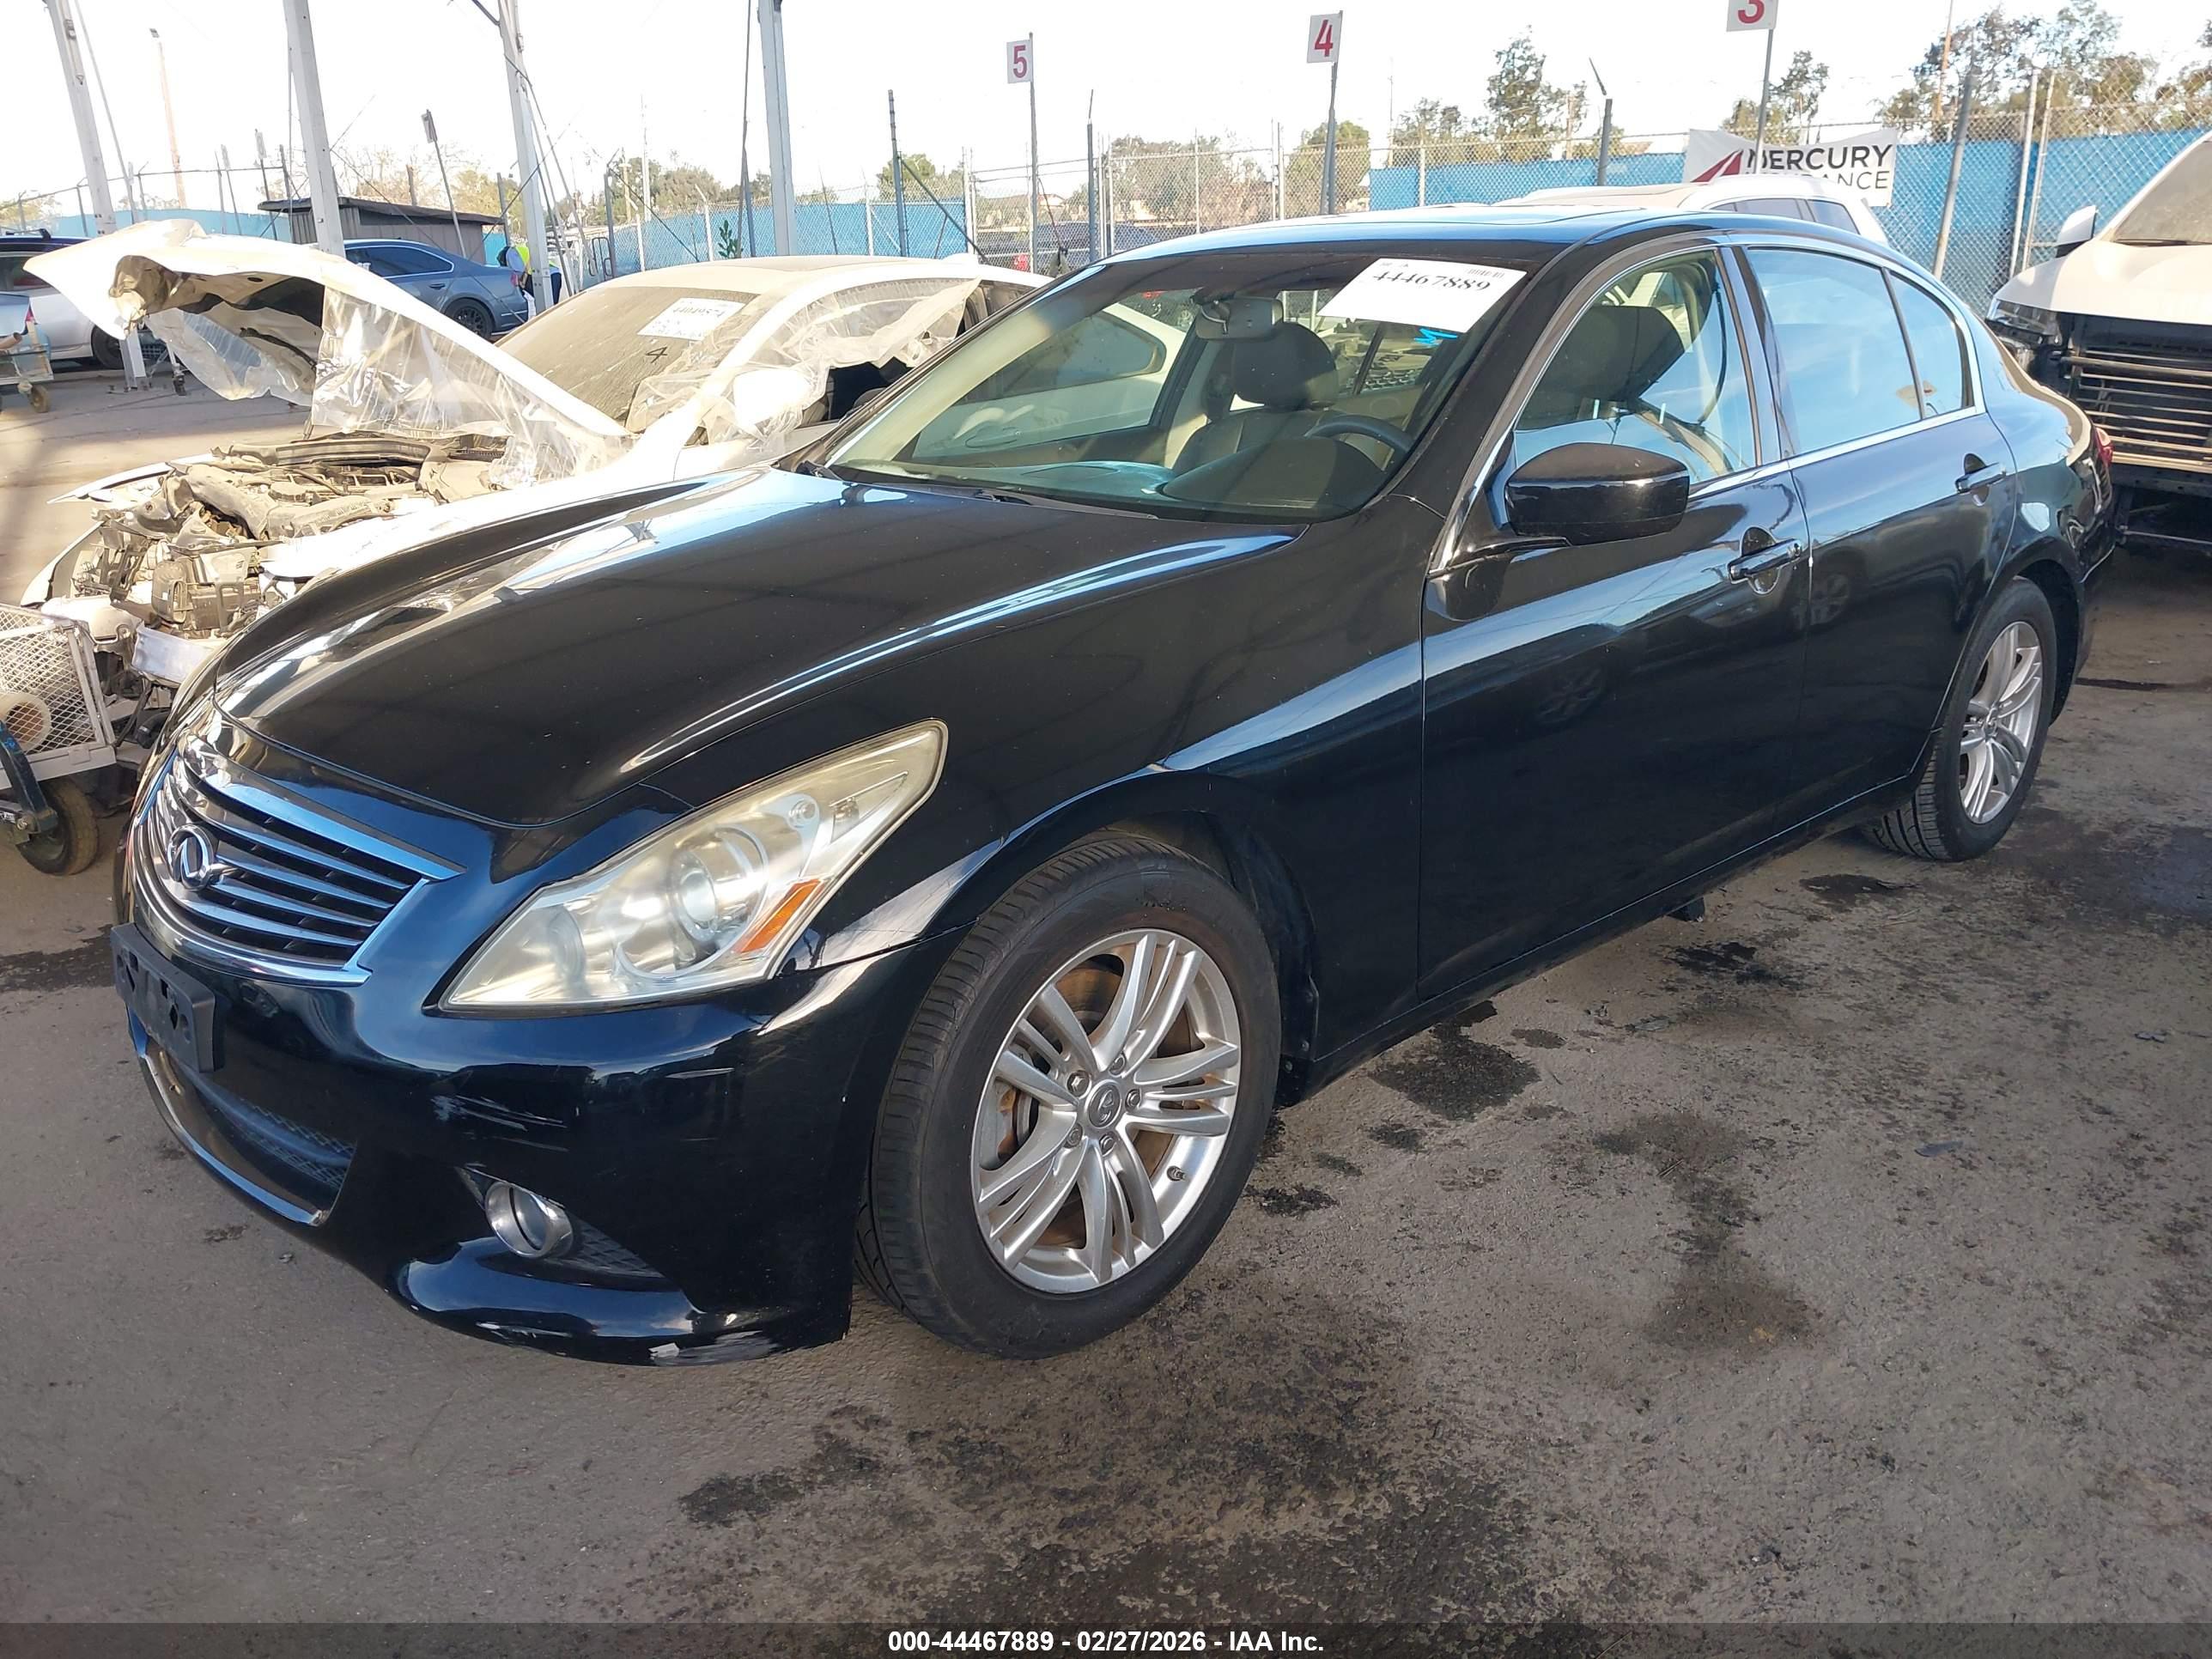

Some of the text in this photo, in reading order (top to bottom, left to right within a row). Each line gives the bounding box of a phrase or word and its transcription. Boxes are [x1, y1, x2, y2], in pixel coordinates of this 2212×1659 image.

[1738, 0, 1765, 24] 3
[1314, 19, 1334, 58] 4
[1013, 44, 1028, 79] 5
[1373, 270, 1491, 291] 44467889
[645, 346, 668, 364] 4
